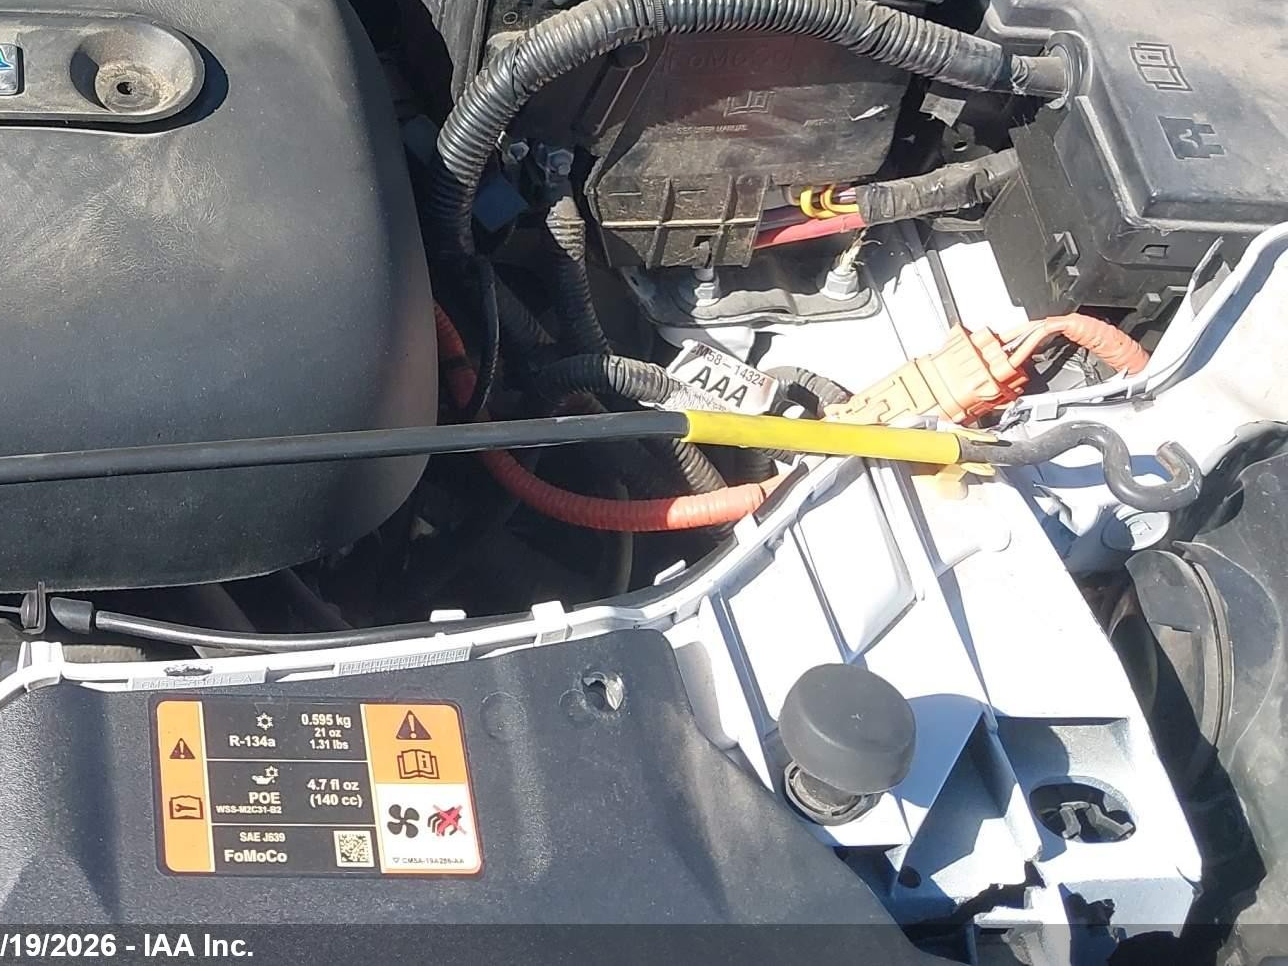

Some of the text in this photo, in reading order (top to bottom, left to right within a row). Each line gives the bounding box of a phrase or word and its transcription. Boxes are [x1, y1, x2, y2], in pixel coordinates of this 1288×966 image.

[688, 365, 749, 408] AAA
[301, 714, 352, 729] 0.595 kg
[314, 728, 342, 738] 21 oz
[229, 735, 276, 747] R-134a
[309, 739, 349, 750] 1.31 lbs
[307, 778, 360, 791] 4.7 fl oz
[248, 792, 281, 804] POE
[310, 794, 362, 808] (140 cc)
[239, 832, 286, 842] SAE J639
[224, 849, 287, 863] FoMoCo
